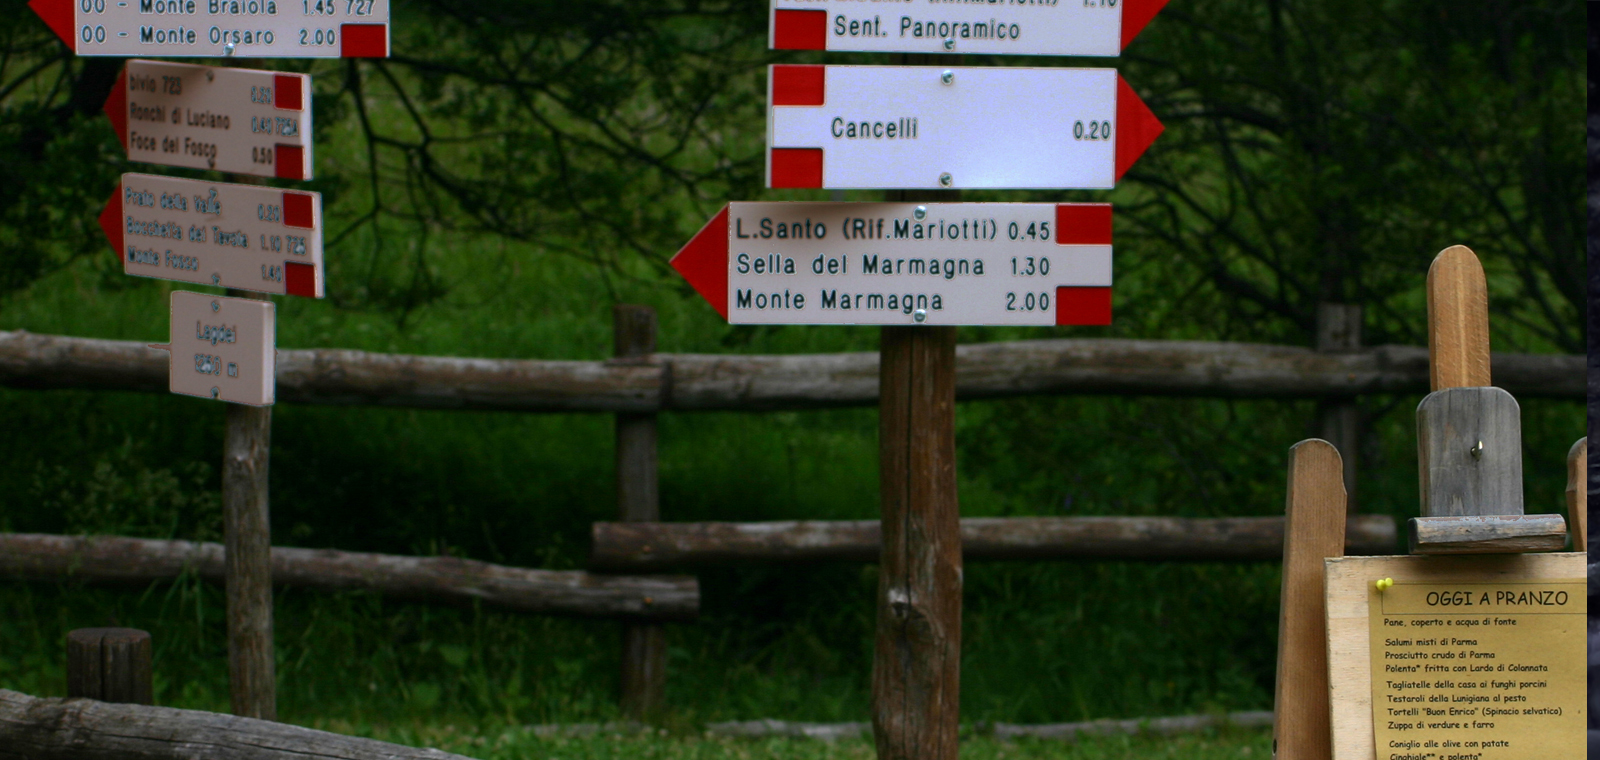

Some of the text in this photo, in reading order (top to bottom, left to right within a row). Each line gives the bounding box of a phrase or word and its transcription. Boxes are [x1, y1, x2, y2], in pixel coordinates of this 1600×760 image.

[80, 0, 104, 15] 00
[139, 0, 196, 15] Monte
[303, 0, 335, 16] 1.45
[346, 0, 374, 15] 727
[80, 24, 105, 45] 00
[139, 25, 197, 45] Monte
[208, 25, 275, 45] Orsaro
[299, 27, 336, 46] 2.00
[834, 15, 1020, 40] Sent. Panoramico
[172, 107, 181, 124] di
[187, 109, 230, 130] Luciano
[830, 117, 1112, 141] Cancelli 0.20
[130, 132, 273, 165] Foce del Fosco 0.50
[160, 193, 188, 211] della
[189, 225, 206, 243] del
[736, 218, 1051, 241] L.Santo (Rif.Mariotti) 0.45
[127, 246, 160, 264] Monte
[165, 250, 199, 271] Fosco
[736, 253, 1051, 279] Sella del Marmagna 1.30
[736, 289, 1050, 315] Monte Marmagna 2.00
[1426, 591, 1569, 606] OGGI A PRANZO
[1384, 618, 1407, 627] Pane,
[1411, 618, 1443, 628] coperto
[1455, 619, 1479, 629] acqua
[1482, 618, 1490, 626] di
[1494, 618, 1517, 626] fonte
[1385, 638, 1478, 647] Salumi misti di Parma
[1385, 650, 1495, 660] Prosciutto crudo di Parma
[1424, 664, 1449, 673] fritta
[1470, 664, 1494, 672] Lardo
[1497, 664, 1505, 672] di
[1508, 664, 1548, 672] Colonnata
[1386, 681, 1431, 691] Tagliatelle
[1434, 680, 1455, 689] della
[1480, 681, 1488, 689] ai
[1490, 680, 1516, 690] funghi
[1519, 680, 1547, 690] porcini
[1387, 694, 1527, 704] Testaroli della Lunigiana al pesto
[1387, 707, 1563, 717] Tortelli "Buon Enrico" (Spinacio selvatico)
[1387, 721, 1413, 731] Zuppa
[1416, 721, 1425, 730] di
[1428, 720, 1460, 729] verdure
[1472, 720, 1495, 729] farro
[1389, 740, 1421, 750] Coniglio
[1424, 740, 1439, 748] alle
[1442, 740, 1461, 748] olive
[1481, 740, 1510, 750] patate
